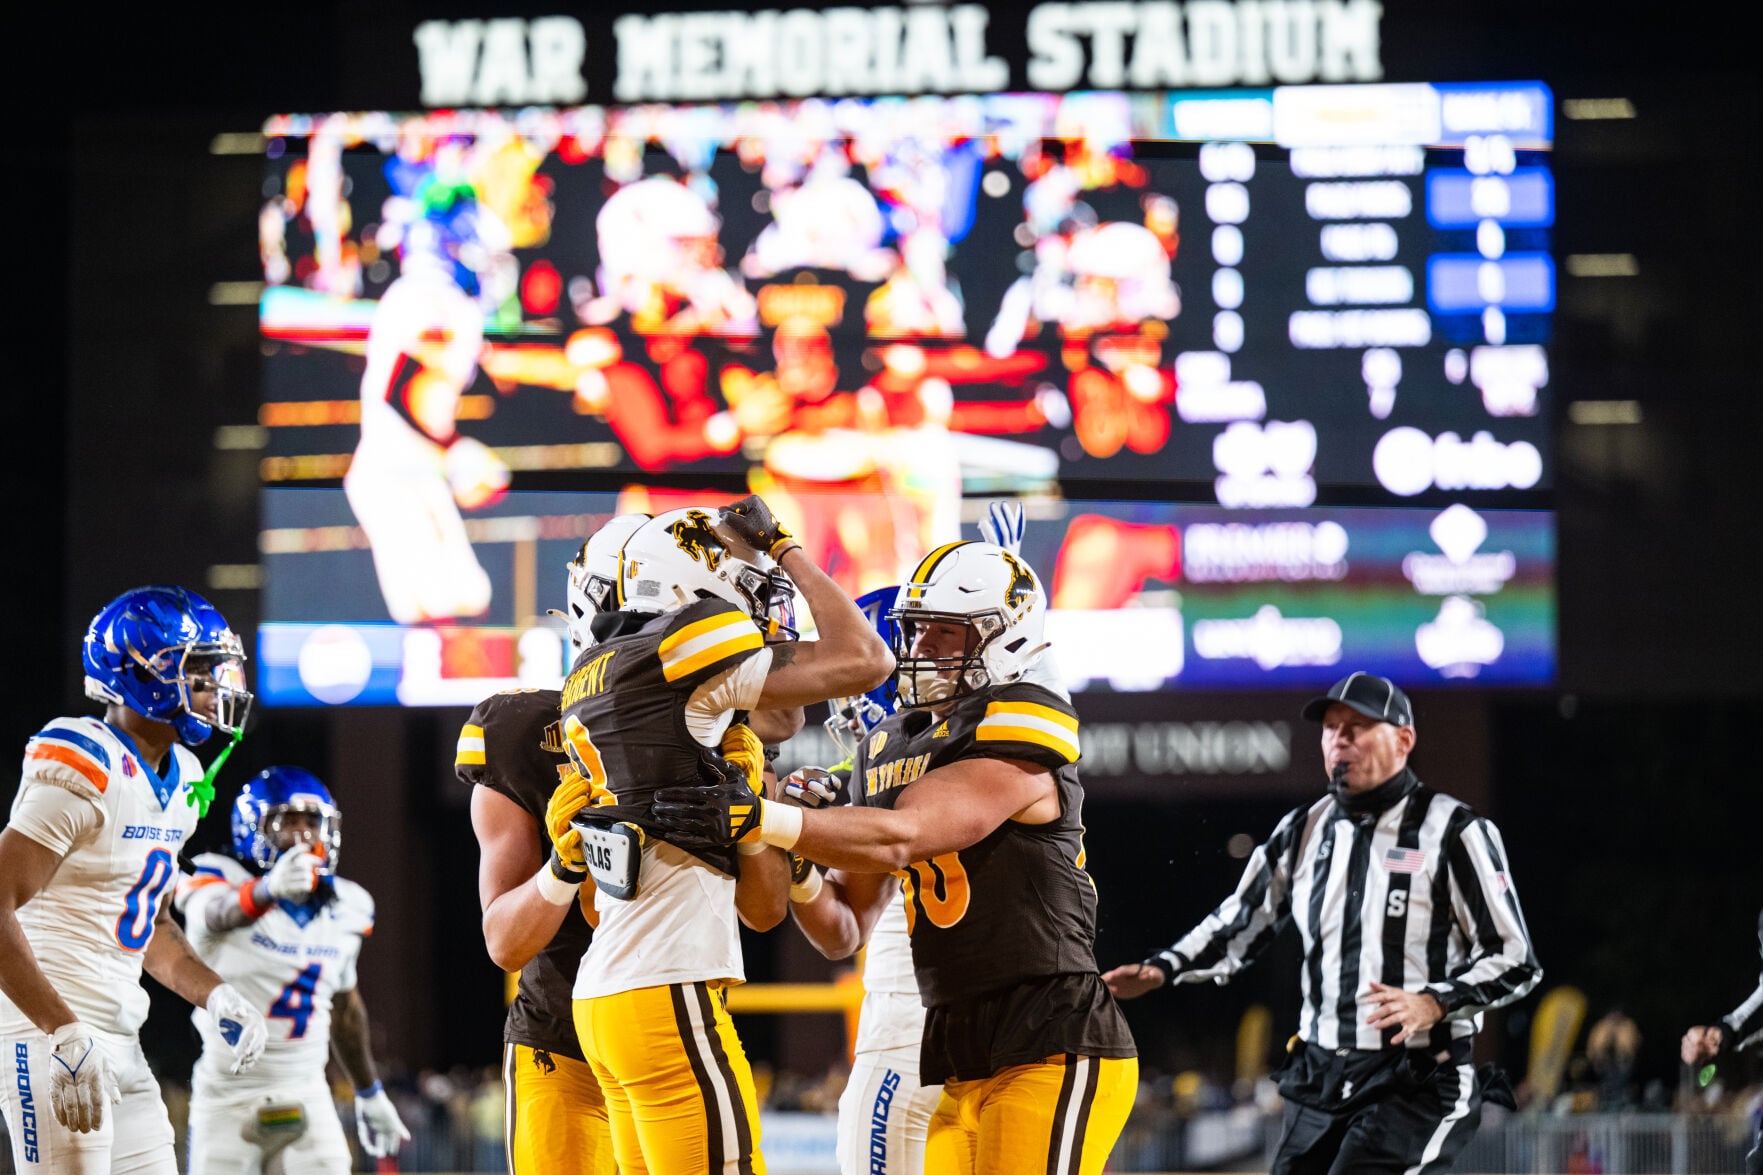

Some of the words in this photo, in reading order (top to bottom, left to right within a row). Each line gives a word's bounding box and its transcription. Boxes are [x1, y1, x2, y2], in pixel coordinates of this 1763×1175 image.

[414, 16, 587, 106] WAR
[613, 6, 1008, 102] MEMORIAL
[1026, 0, 1381, 90] STADIUM
[1135, 719, 1290, 776] UNION
[121, 825, 162, 841] BOISE
[1317, 840, 1332, 860] S
[115, 846, 173, 953] 0
[1387, 889, 1408, 917] S
[265, 961, 323, 1040] 4
[15, 1041, 40, 1164] BRONCOS
